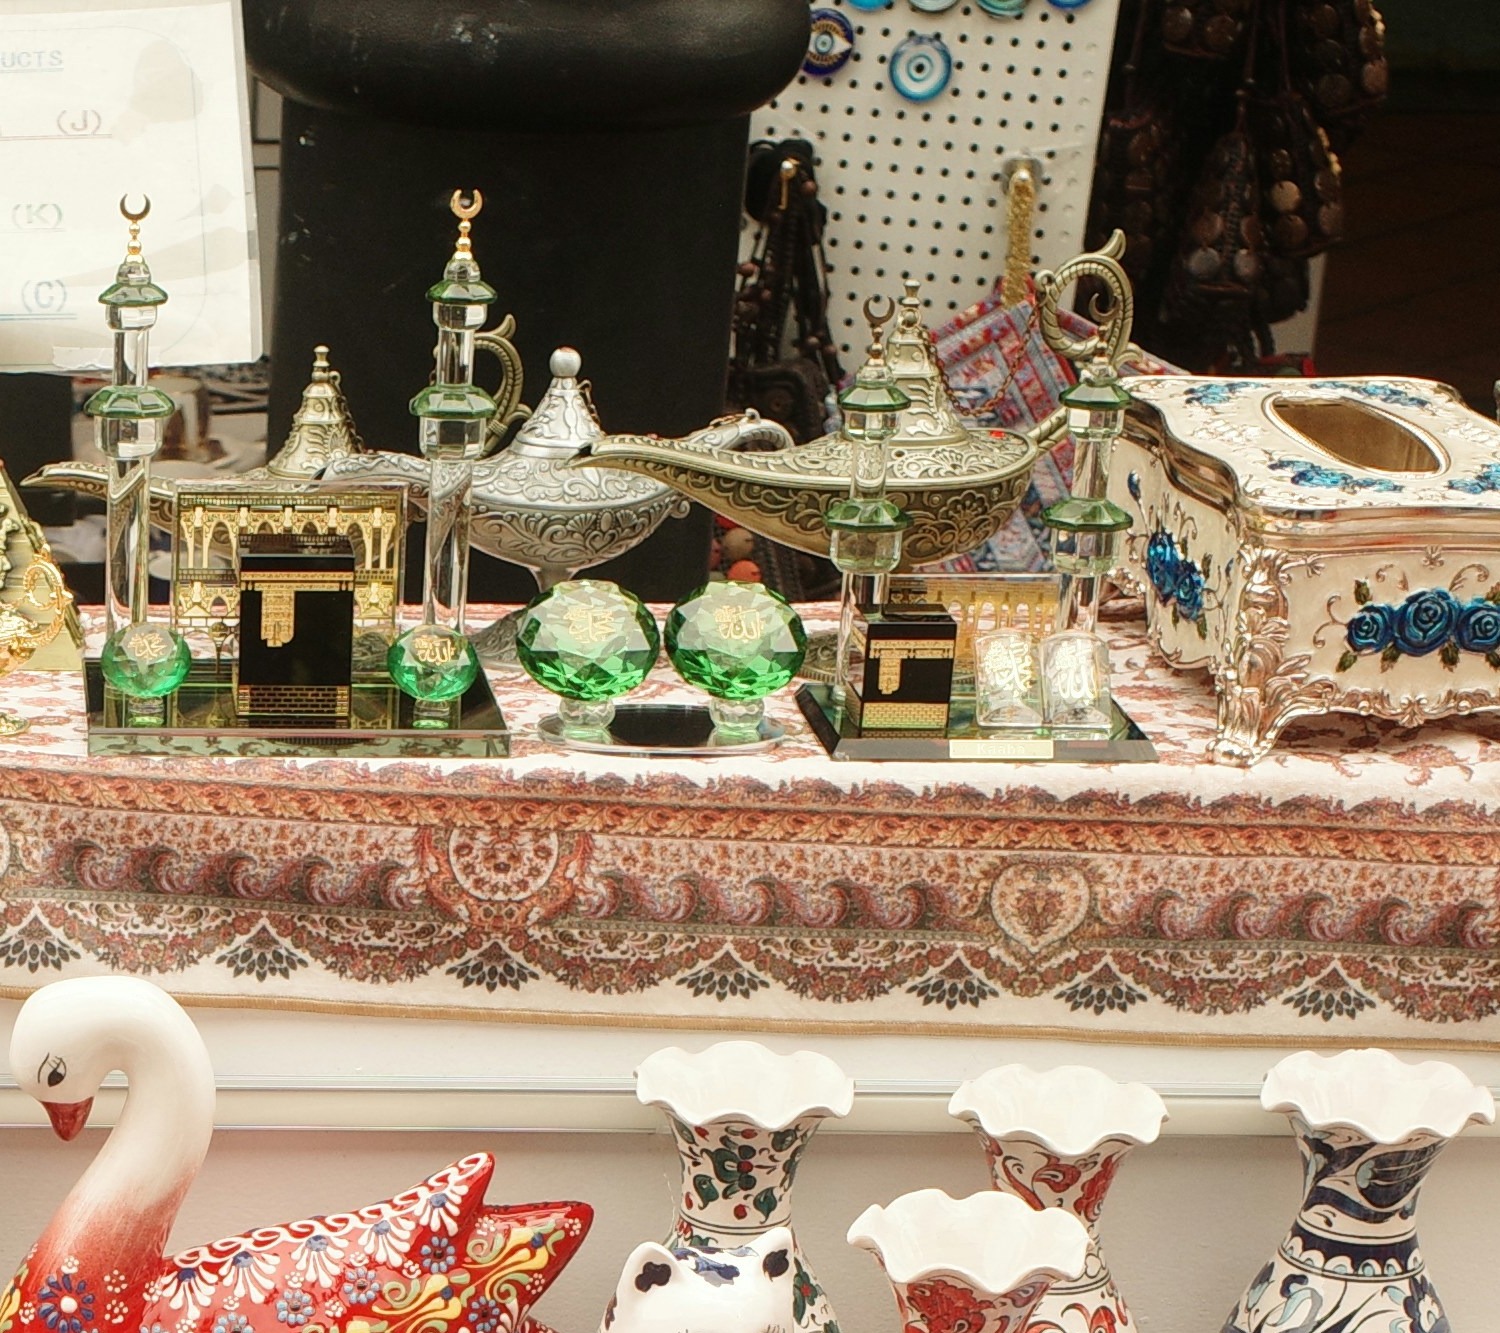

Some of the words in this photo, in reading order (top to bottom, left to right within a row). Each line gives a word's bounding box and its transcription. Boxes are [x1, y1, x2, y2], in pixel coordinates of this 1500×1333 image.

[56, 108, 104, 136] (J)
[11, 203, 64, 231] (K)
[20, 279, 68, 314] (C)
[976, 743, 1026, 755] Kaaba
